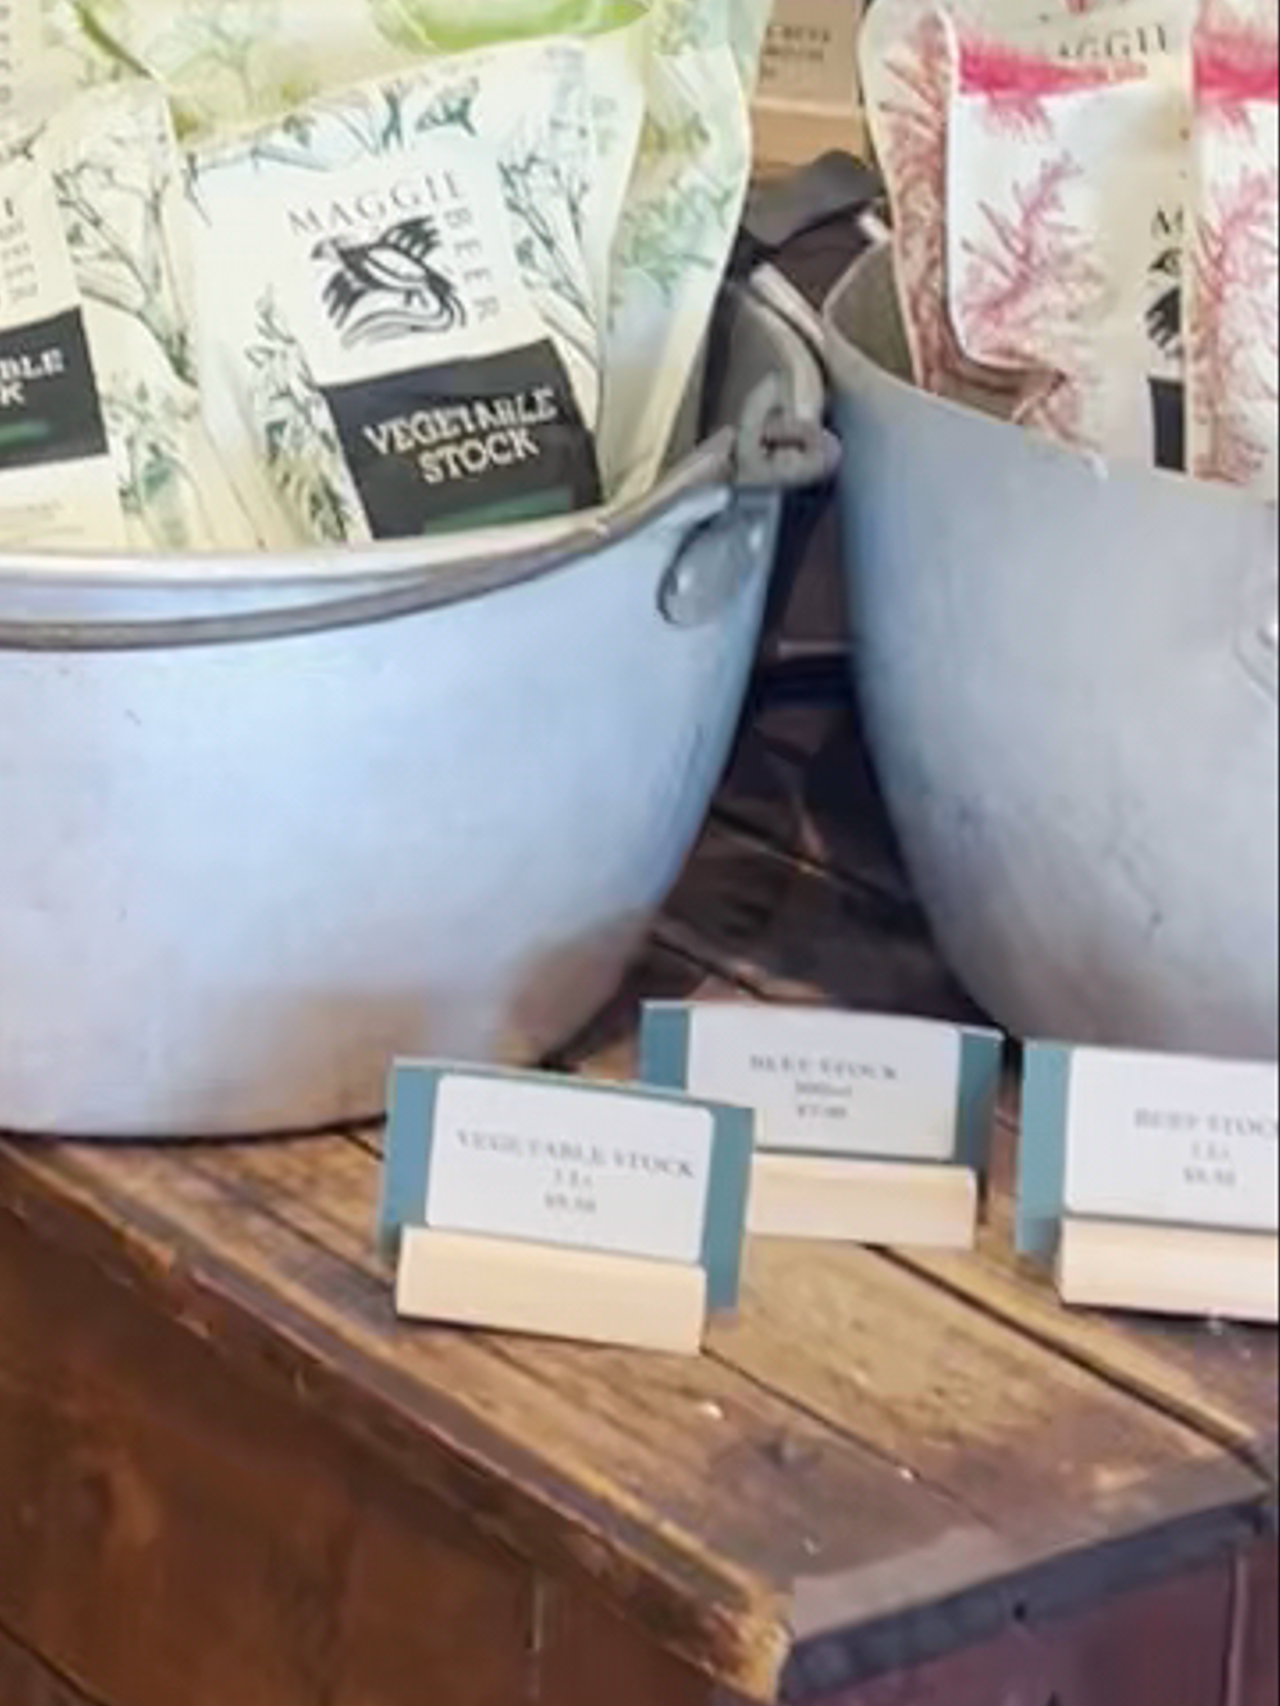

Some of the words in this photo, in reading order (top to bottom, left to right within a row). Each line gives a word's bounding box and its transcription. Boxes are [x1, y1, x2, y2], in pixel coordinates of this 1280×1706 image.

[290, 168, 461, 236] MAGGIE
[443, 206, 500, 322] BEER
[362, 387, 558, 455] VEGETABLE
[417, 428, 540, 484] STOCK
[456, 1129, 604, 1166] VEGETABLE
[611, 1147, 695, 1179] STOCK
